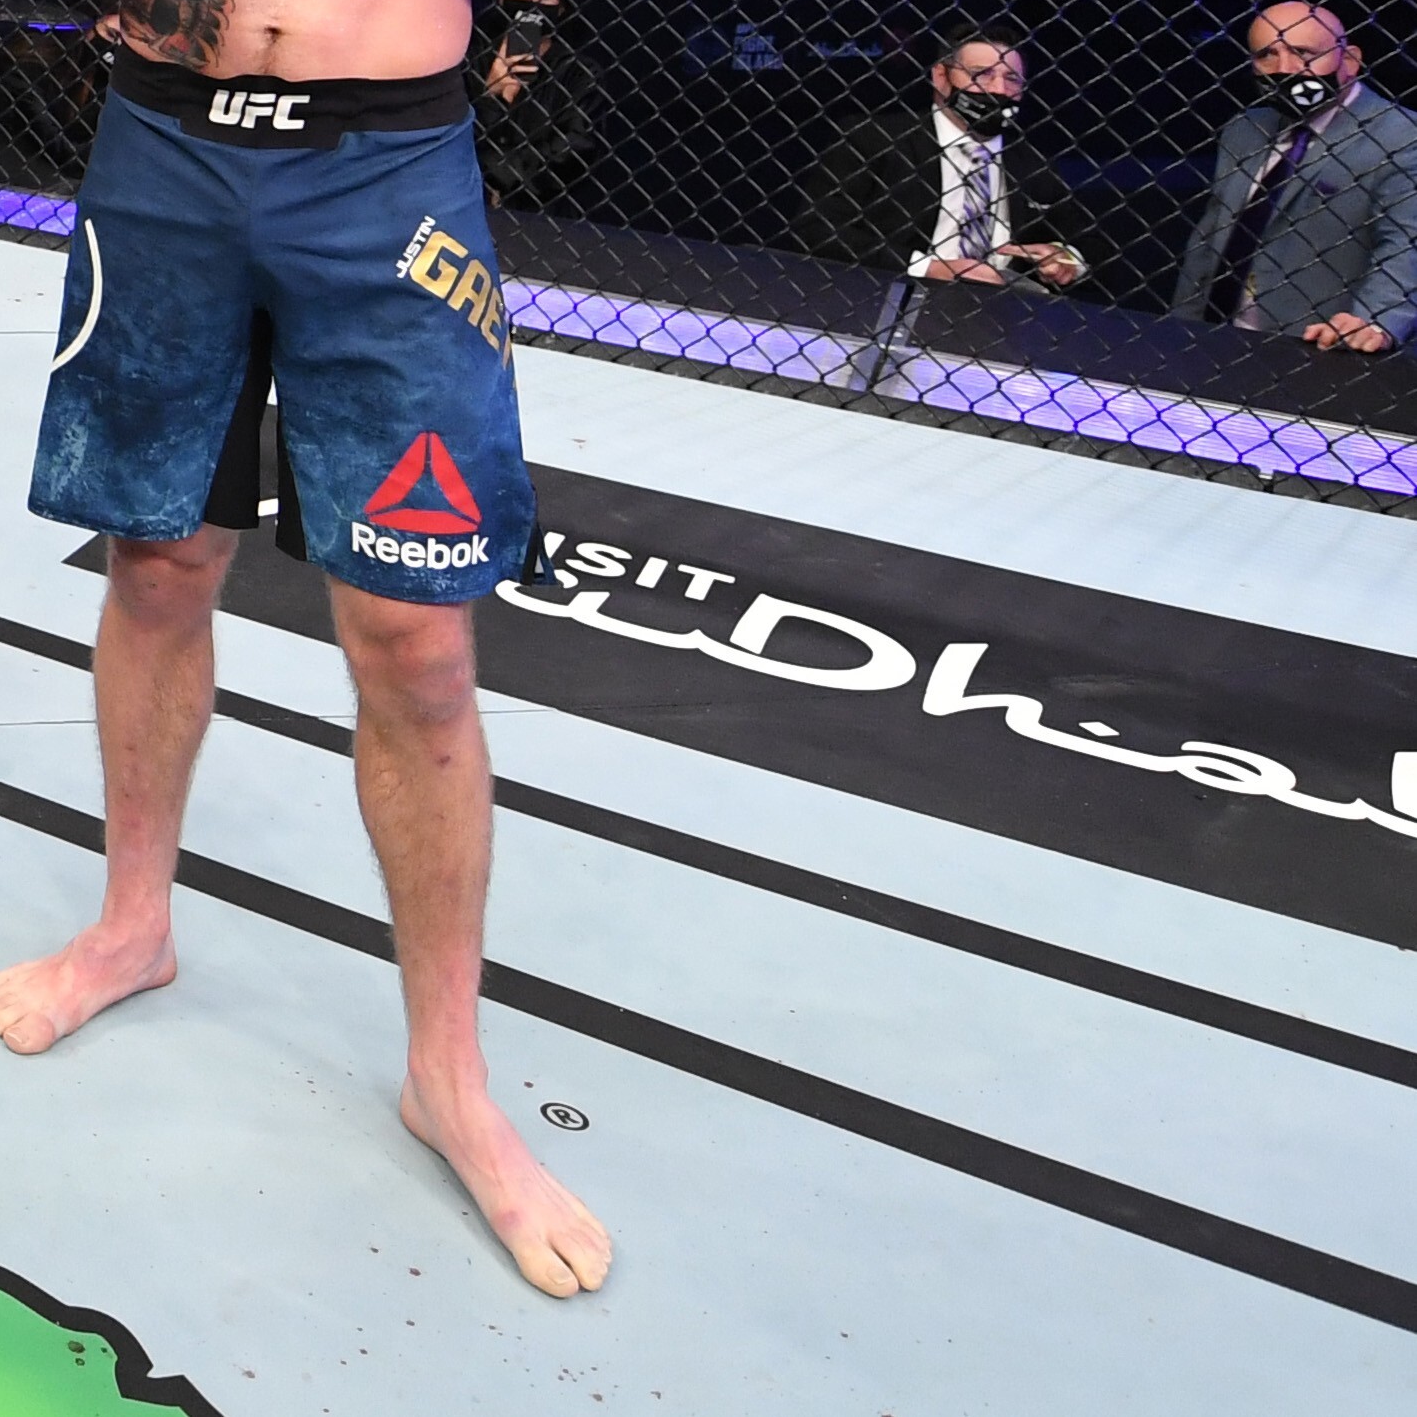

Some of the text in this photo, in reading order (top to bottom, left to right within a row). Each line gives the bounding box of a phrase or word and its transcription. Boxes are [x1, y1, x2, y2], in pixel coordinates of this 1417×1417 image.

[208, 88, 311, 130] UFC
[395, 214, 437, 279] JUSTIN
[409, 230, 512, 371] GAE
[351, 520, 489, 570] Reebok
